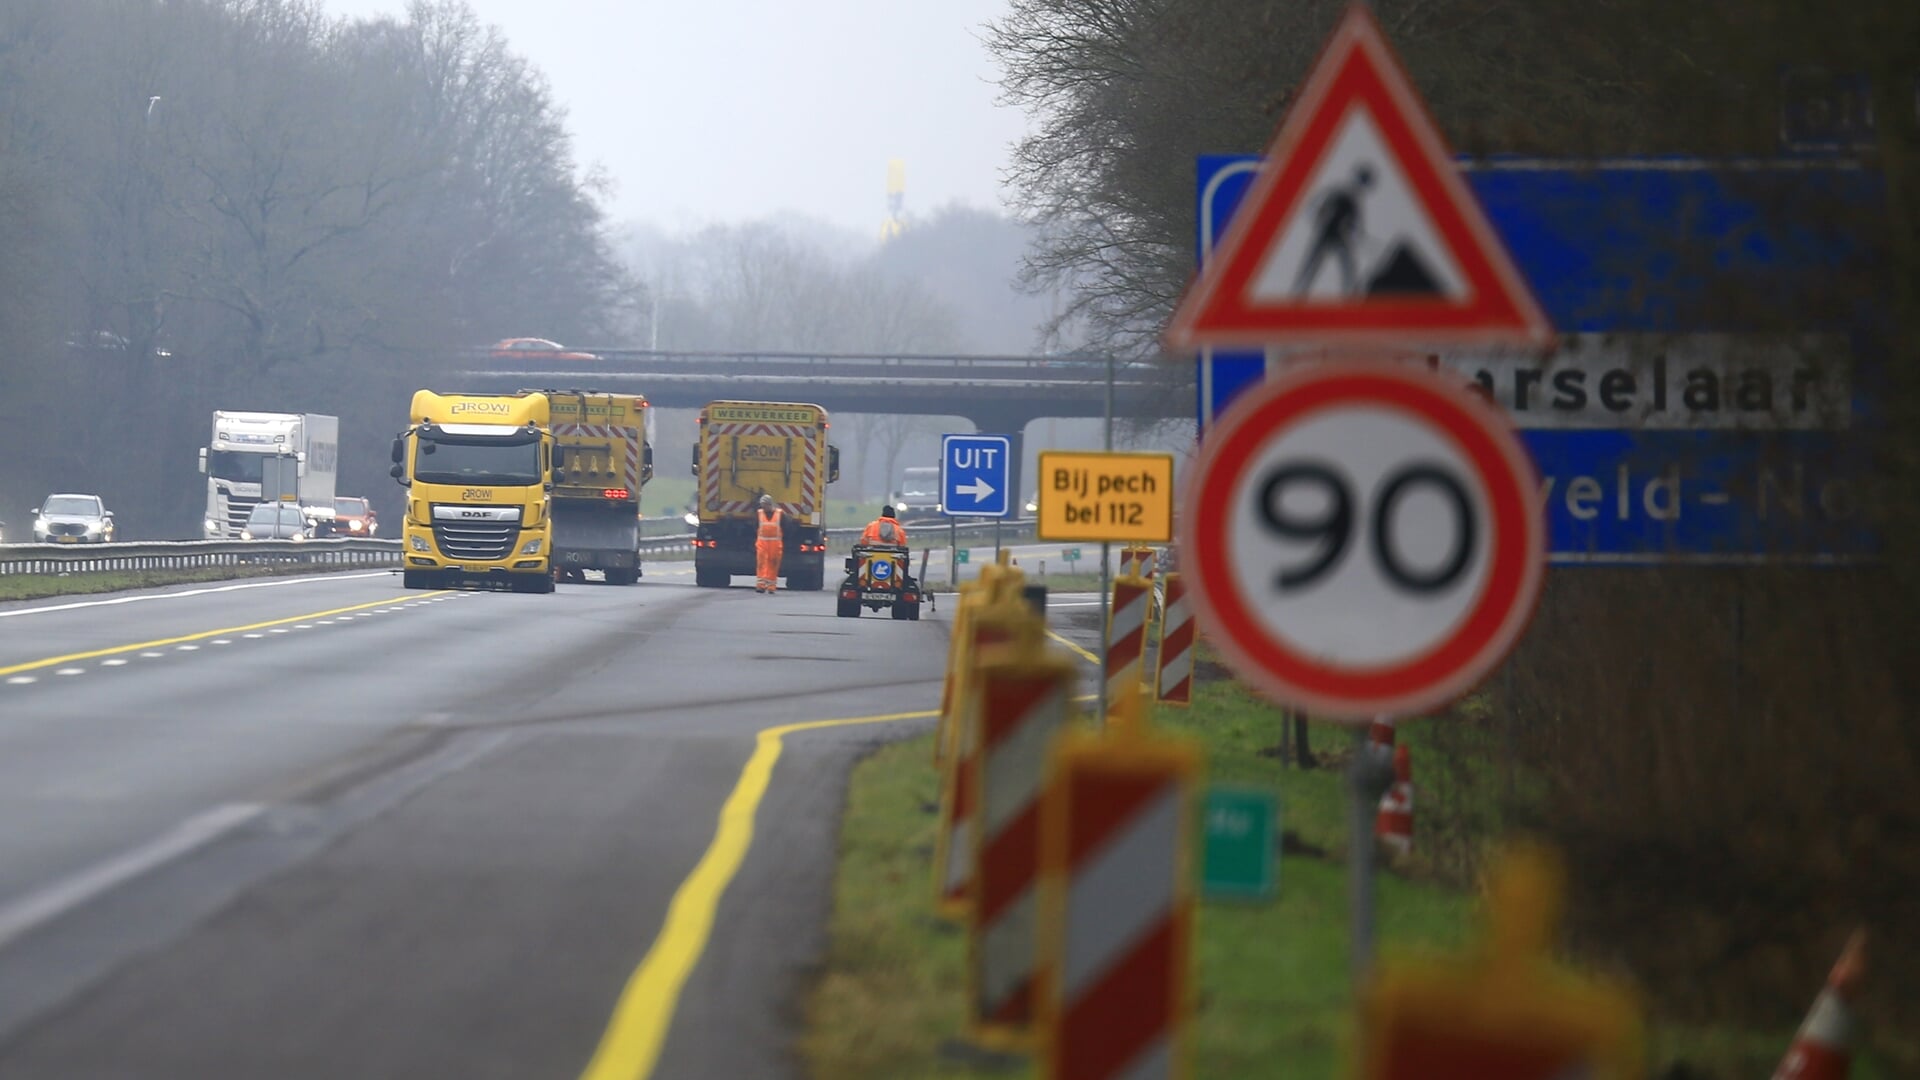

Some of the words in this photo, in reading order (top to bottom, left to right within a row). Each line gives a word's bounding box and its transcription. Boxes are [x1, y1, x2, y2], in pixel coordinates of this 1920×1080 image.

[467, 402, 510, 413] ROWI
[718, 409, 809, 421] WERKVERKEER
[751, 445, 783, 457] ROWI
[954, 447, 998, 470] UIT
[1053, 468, 1089, 498] Bij
[1097, 471, 1156, 495] pech
[468, 489, 492, 499] ROWI
[1065, 502, 1100, 524] bel
[1108, 503, 1144, 526] 112
[1257, 458, 1478, 594] 90
